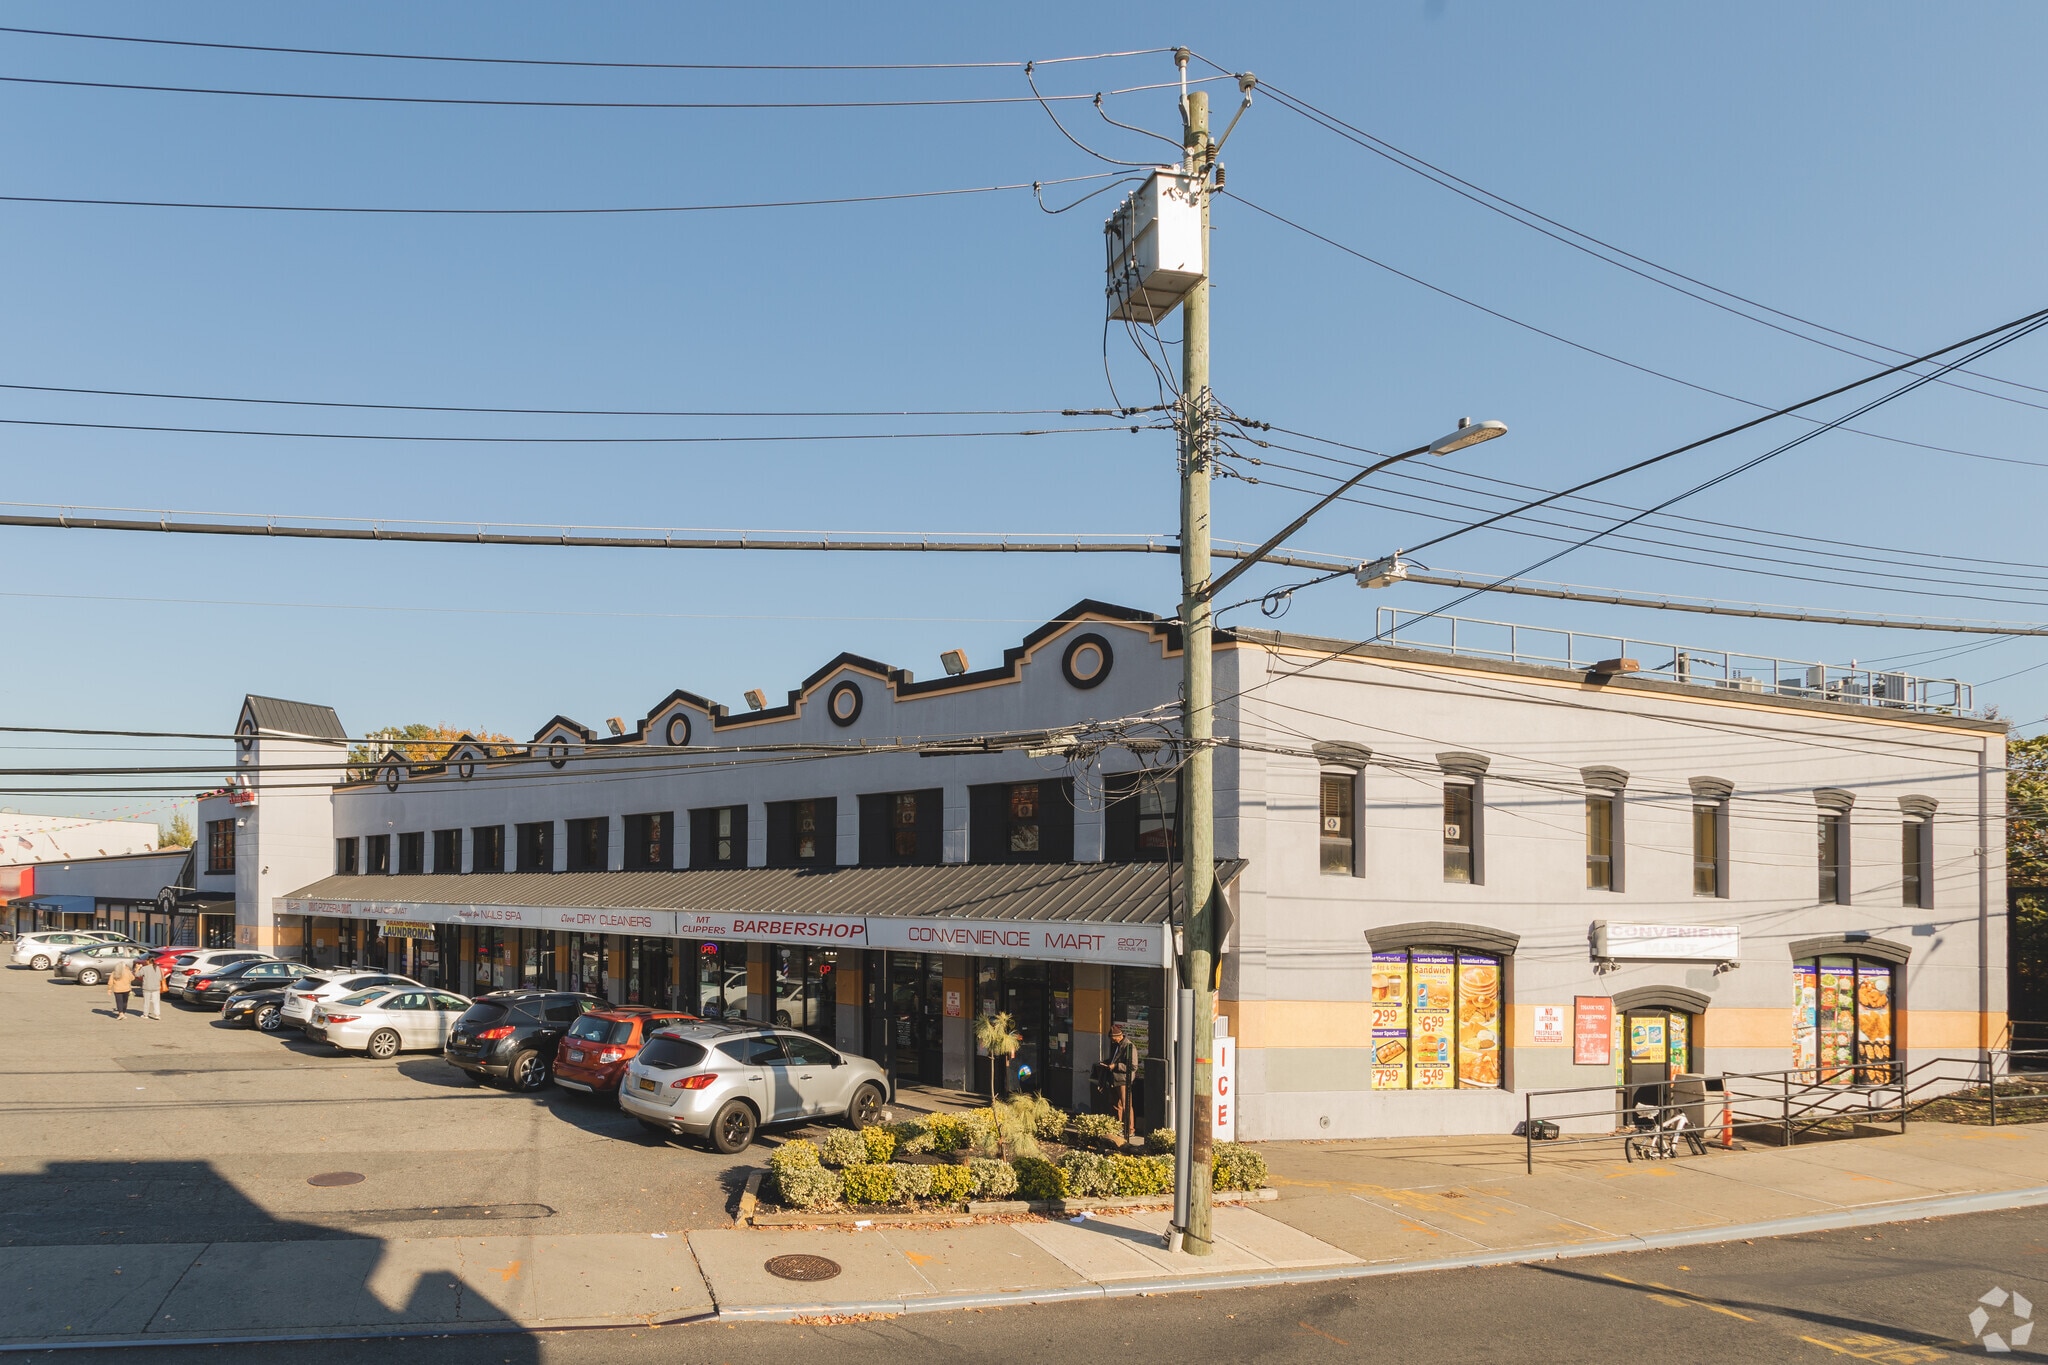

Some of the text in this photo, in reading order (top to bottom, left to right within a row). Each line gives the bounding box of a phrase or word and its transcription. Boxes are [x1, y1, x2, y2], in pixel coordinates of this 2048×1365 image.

[481, 910, 503, 920] NAILS
[505, 911, 522, 920] SPA
[561, 914, 652, 928] Clove DRY CLEANERS
[696, 916, 711, 924] MT
[383, 926, 433, 939] LAUNDROMAT
[682, 925, 726, 934] CLIPPERS
[733, 920, 865, 938] BARBERSHOP
[1611, 926, 1736, 938] CONVENIENT
[908, 927, 1105, 950] CONVENIENCE MART
[1118, 938, 1147, 947] 2071
[1646, 943, 1698, 952] MART
[1414, 965, 1451, 974] Sandwich
[1418, 1016, 1444, 1032] $6.99
[1372, 1069, 1398, 1086] $7.99
[1420, 1069, 1444, 1085] $5.49
[1218, 1047, 1228, 1126] ICE
